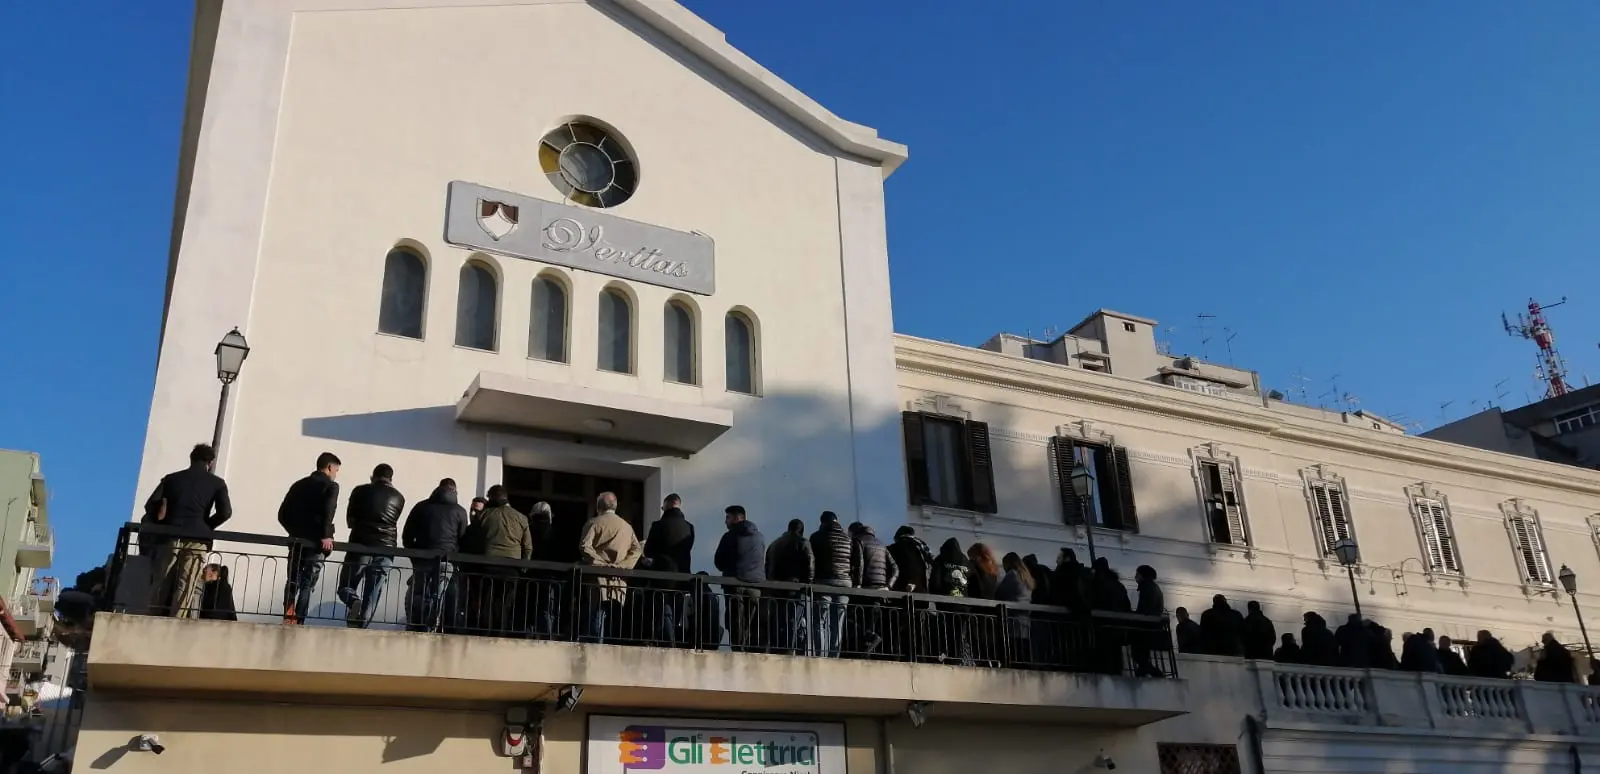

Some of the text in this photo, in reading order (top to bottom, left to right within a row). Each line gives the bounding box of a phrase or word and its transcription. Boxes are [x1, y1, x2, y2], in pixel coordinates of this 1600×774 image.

[542, 217, 689, 278] Veritas
[668, 733, 815, 766] Gli Elettrici
